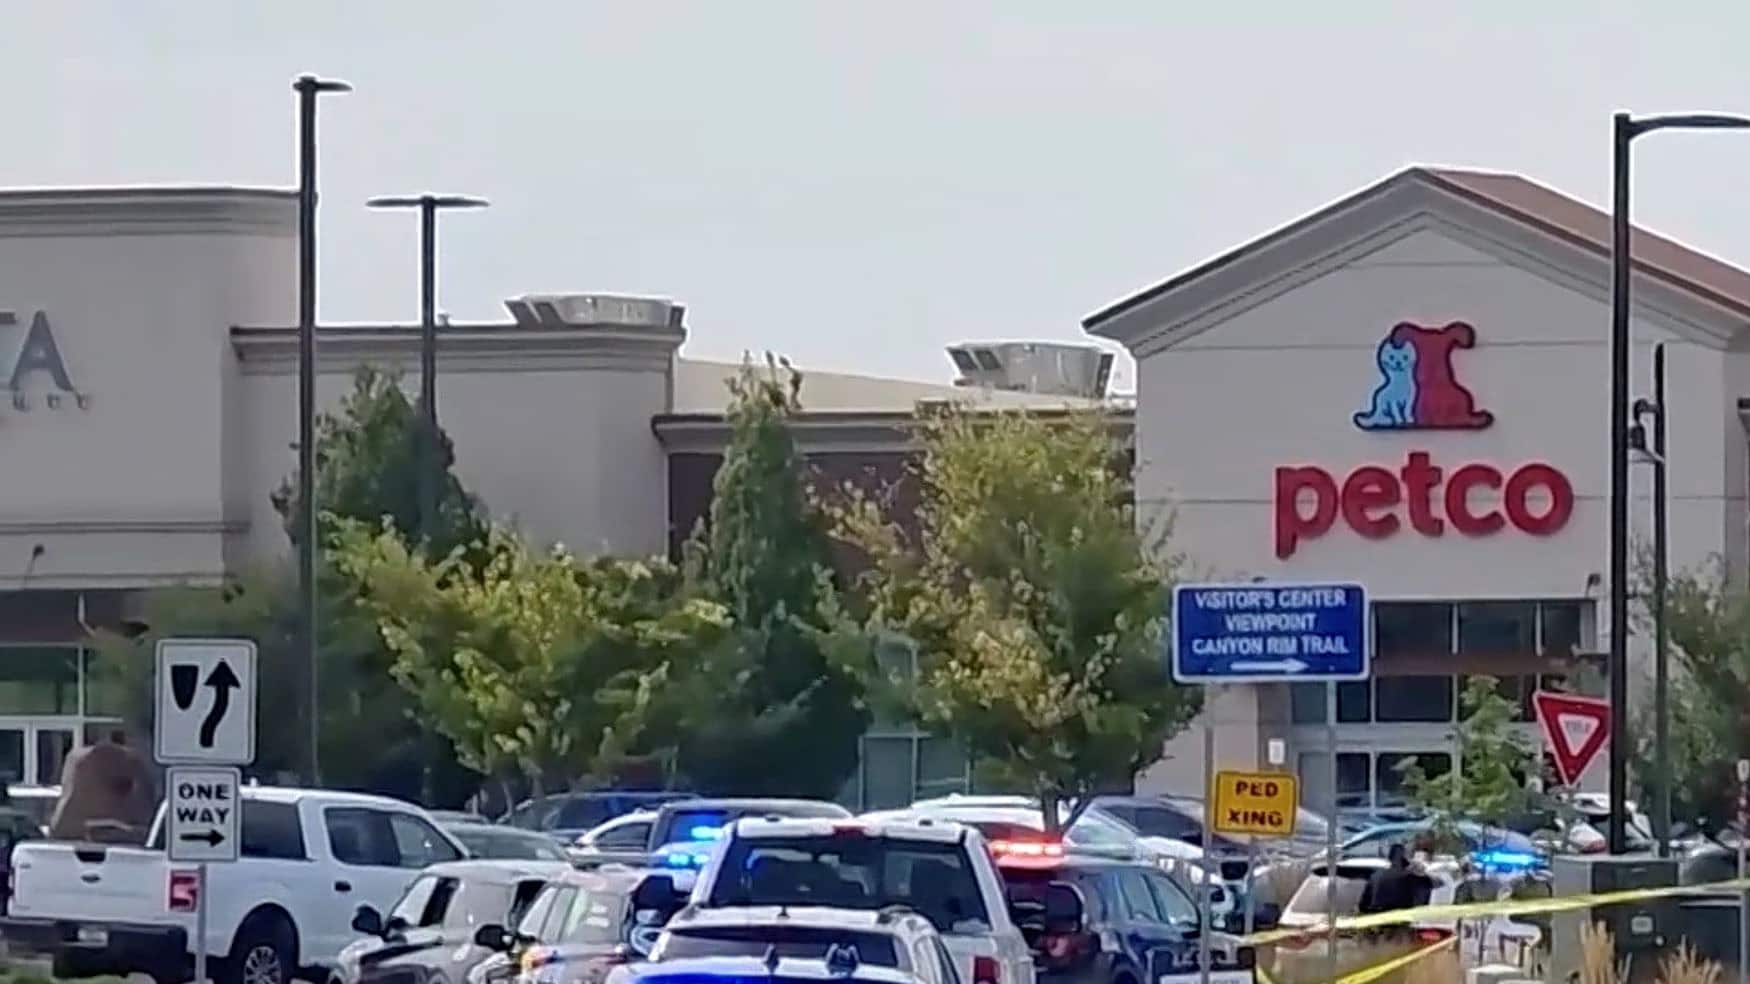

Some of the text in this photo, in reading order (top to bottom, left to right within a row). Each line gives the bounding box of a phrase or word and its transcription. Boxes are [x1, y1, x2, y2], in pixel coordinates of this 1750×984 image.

[1275, 451, 1575, 560] petco
[1195, 588, 1346, 610] VISITOR'S CENTER
[1226, 612, 1317, 632] VIEWPOINT
[1192, 634, 1349, 655] CANYON RIM TRAIL
[178, 783, 231, 800] ONE
[1235, 781, 1278, 797] PED
[177, 807, 230, 824] WAY
[1228, 808, 1284, 827] XING
